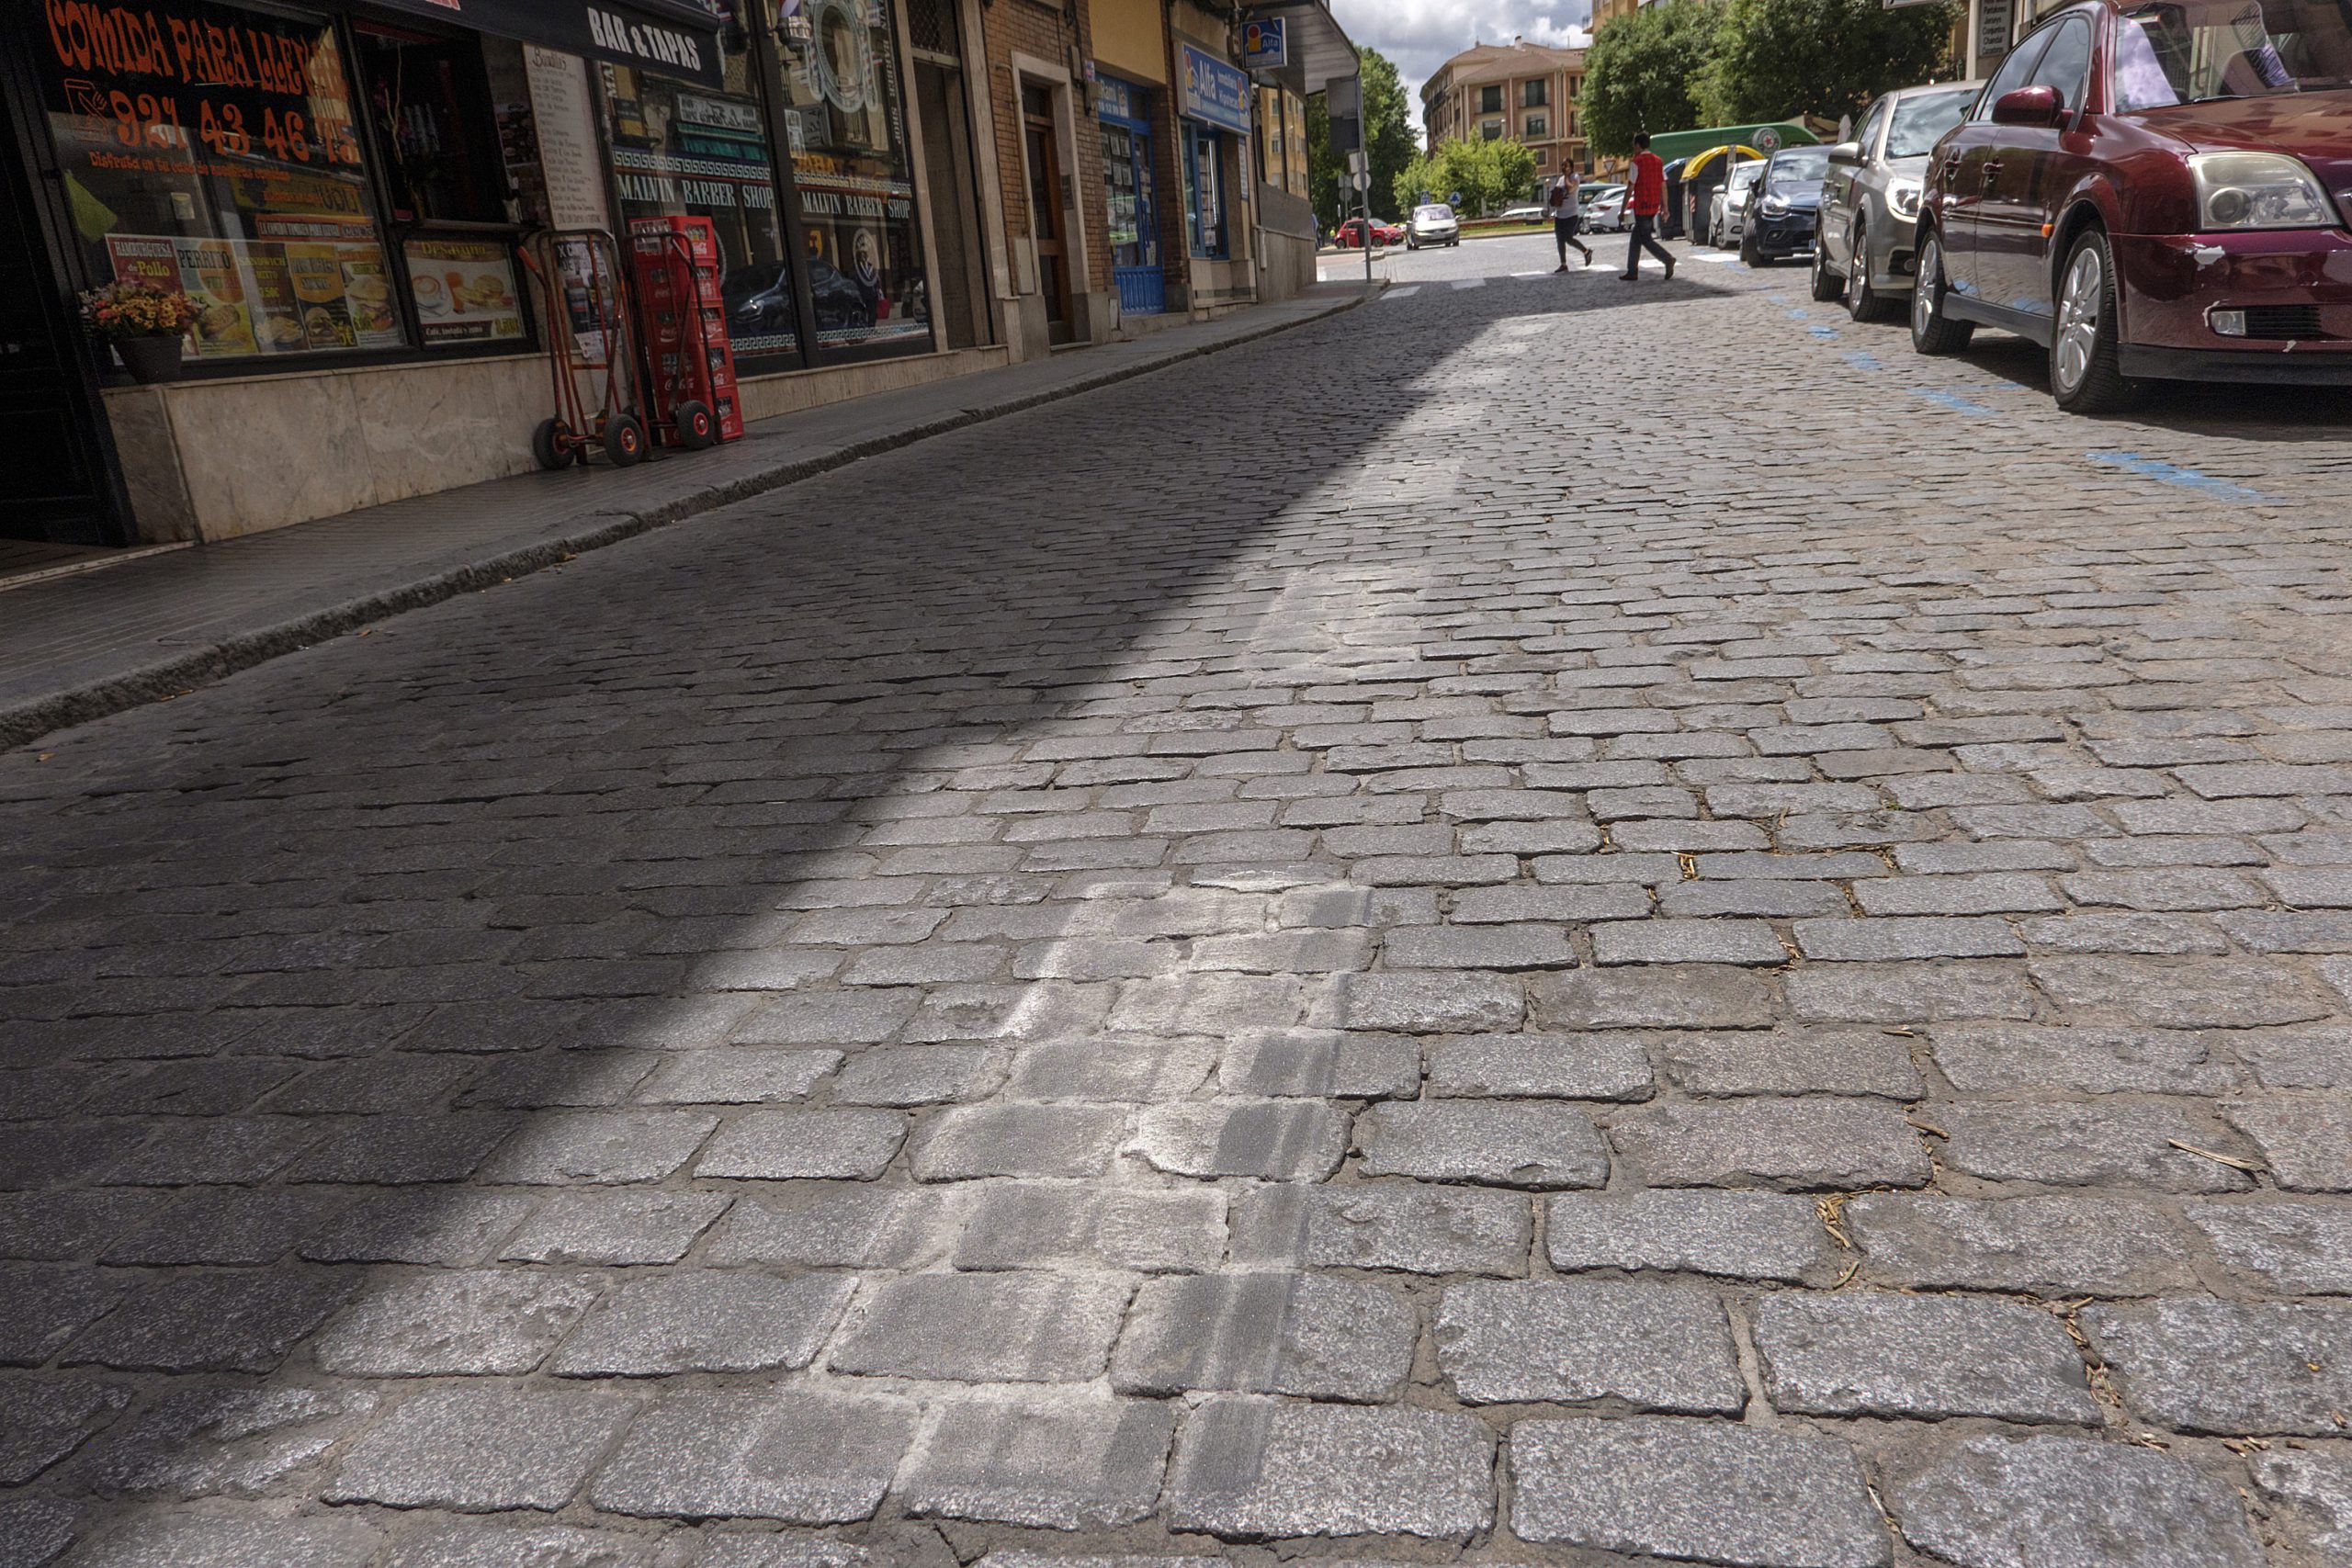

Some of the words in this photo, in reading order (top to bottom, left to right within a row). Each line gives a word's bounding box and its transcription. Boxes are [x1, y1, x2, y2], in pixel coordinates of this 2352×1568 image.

[46, 0, 175, 77] COMIDA
[165, 16, 254, 88] PARA
[246, 28, 350, 102] LLEVAR
[586, 7, 633, 55] BAR
[630, 25, 650, 58] &
[641, 24, 702, 72] TAPAS
[1262, 38, 1278, 49] Alfa
[1199, 59, 1216, 100] Alfa
[109, 89, 187, 149] 921
[200, 98, 251, 156] 43
[264, 107, 311, 163] 46
[315, 117, 357, 164] 75
[890, 106, 902, 145] SHOP
[89, 151, 141, 170] Disfruta
[617, 175, 676, 203] MALVIN
[681, 179, 737, 207] BARBER
[742, 186, 774, 209] SHOP
[801, 191, 842, 215] MALVIN
[845, 195, 885, 218] BARBER
[888, 198, 911, 220] SHOP
[114, 241, 174, 258] HAMBURGUESA
[177, 249, 232, 270] PERRITO
[239, 256, 287, 266] SANDWICH
[421, 242, 486, 258] Desayuno
[136, 261, 171, 277] Pollo
